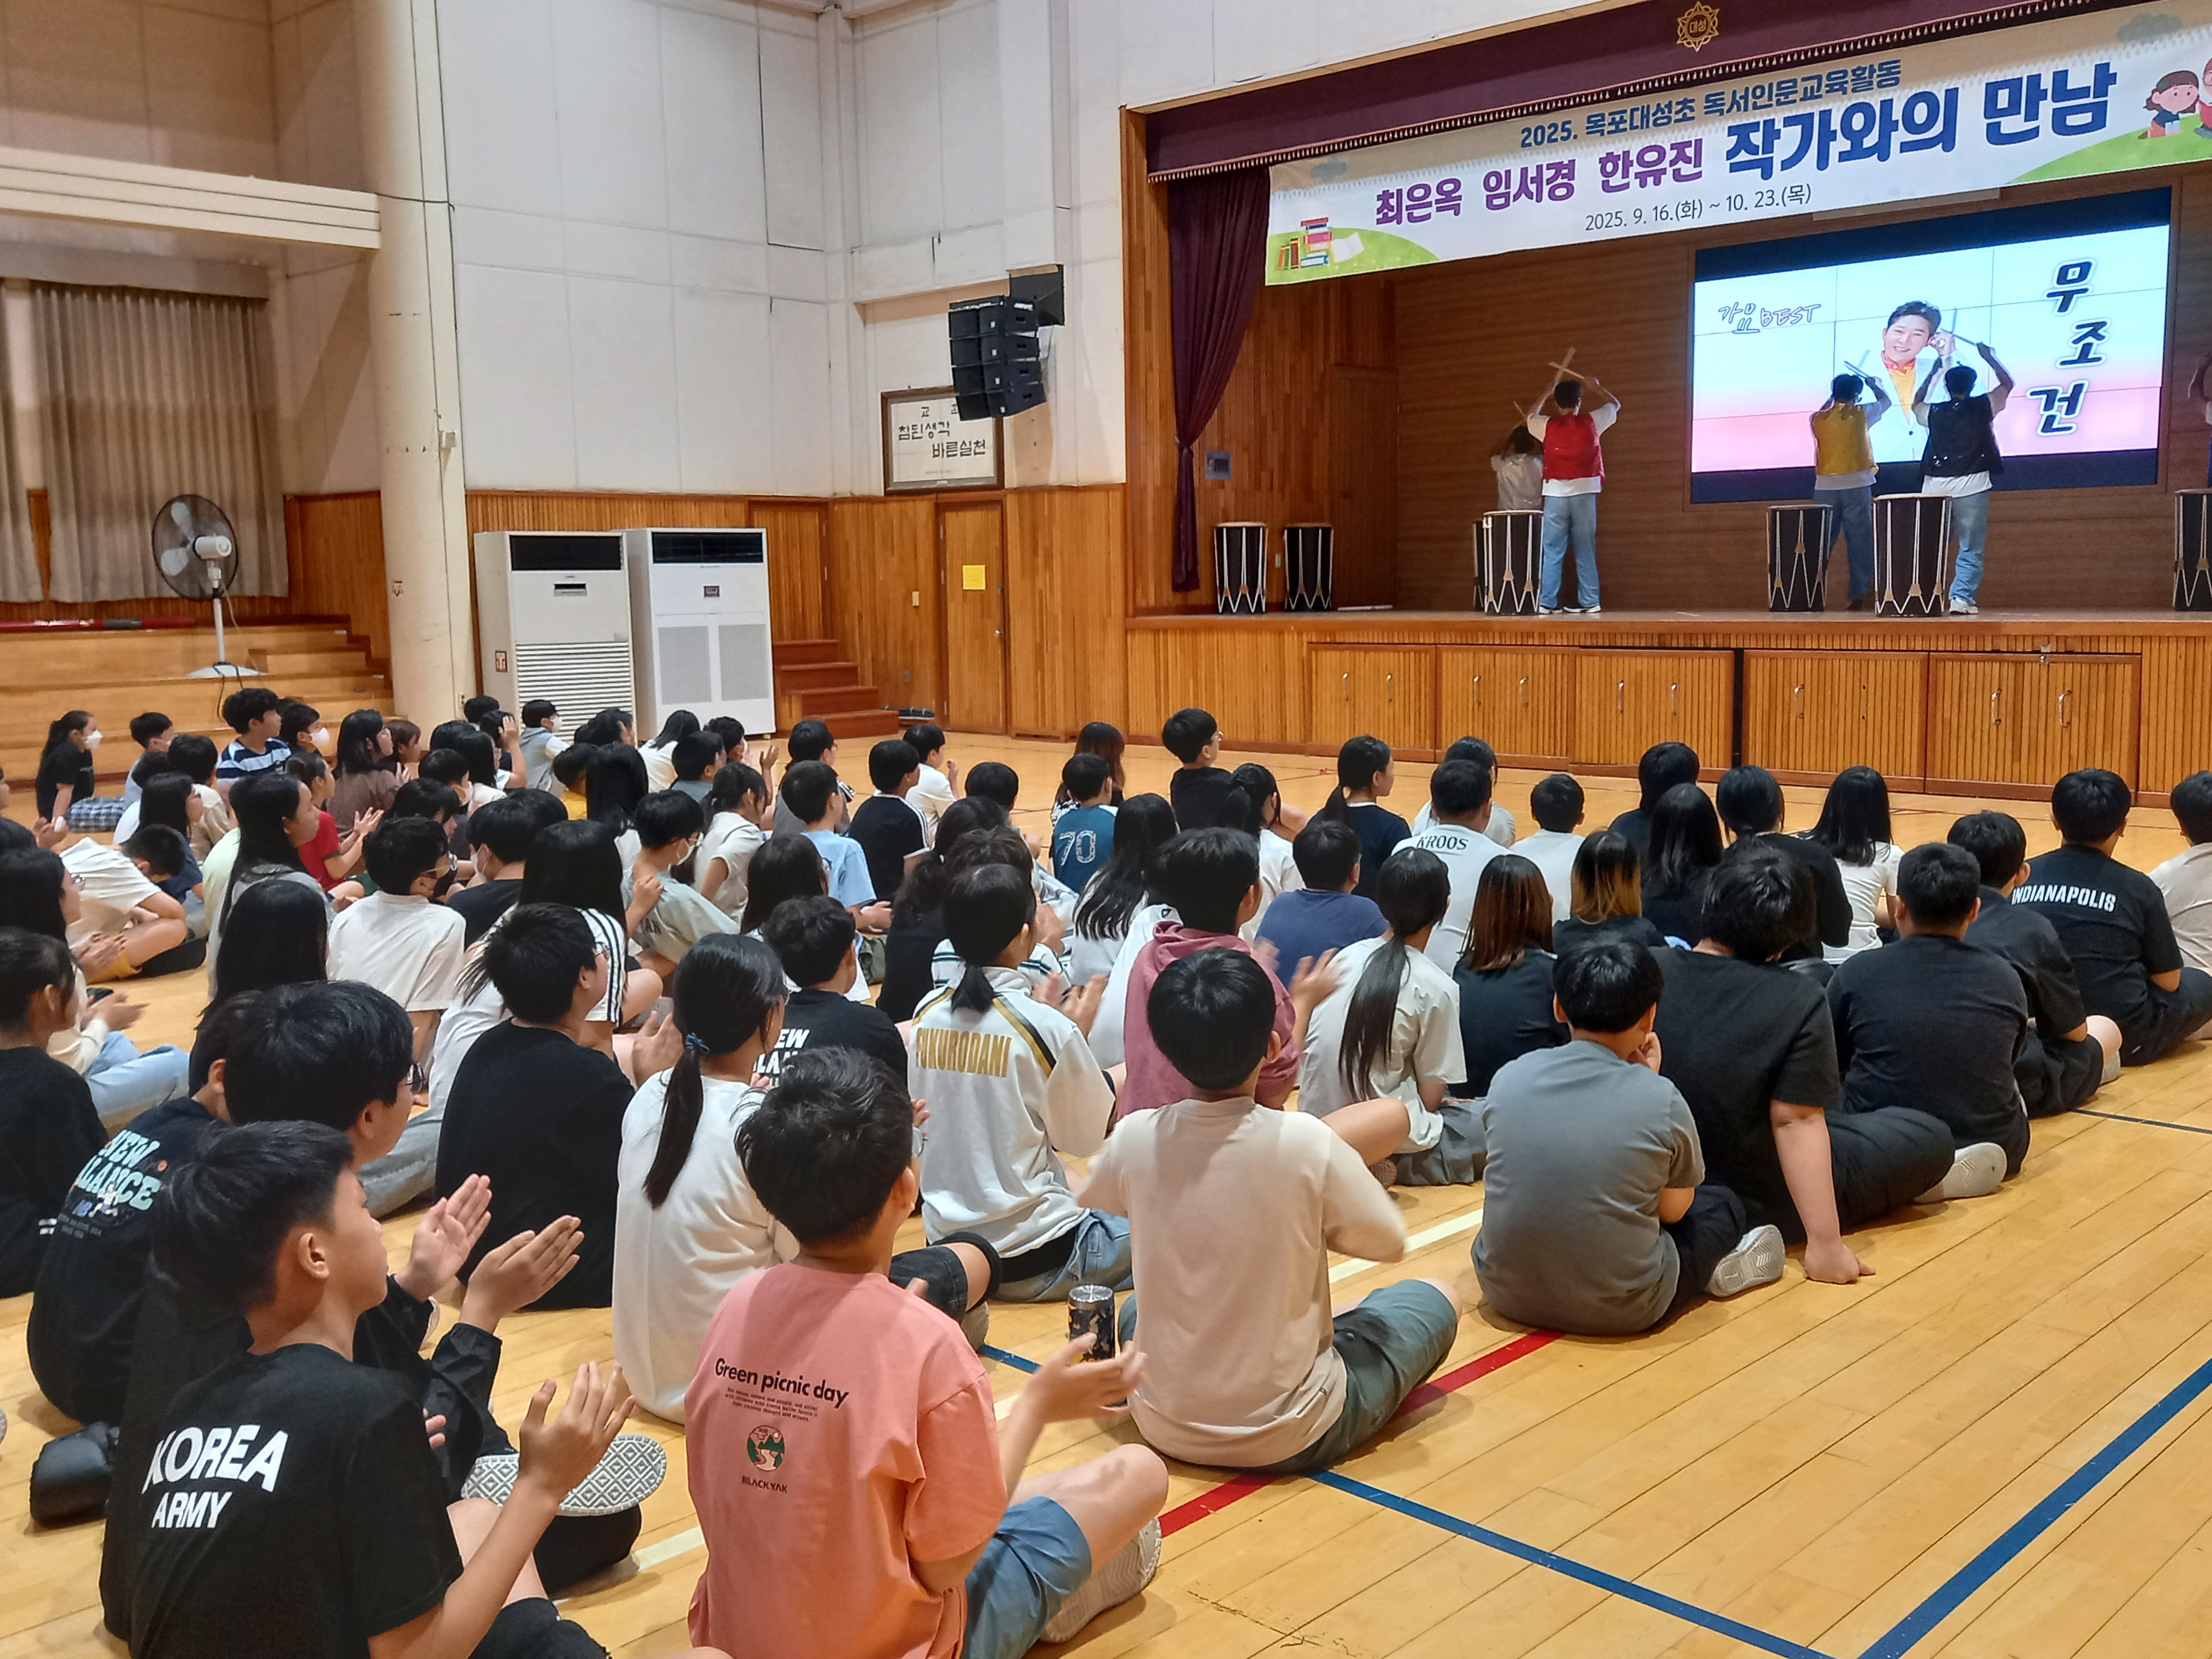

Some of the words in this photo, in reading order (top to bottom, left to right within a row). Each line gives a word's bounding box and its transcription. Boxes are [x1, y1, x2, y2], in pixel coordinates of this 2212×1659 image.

[1689, 18, 1707, 33] 대성
[1520, 120, 1578, 148] 2025.
[1585, 97, 1696, 137] 목포대성초
[1703, 59, 1901, 117] 독서인문교육활동
[1376, 178, 1462, 226] 최은옥
[1483, 159, 1575, 211] 임서경
[1599, 138, 1703, 194] 한유진
[1725, 88, 1959, 181] 작가와의
[1984, 62, 2117, 146] 만남
[1585, 211, 1627, 231] 2025.
[1633, 208, 1647, 225] 9.
[1653, 199, 1703, 222] 16.(화)
[1726, 194, 1748, 211] 10.
[1754, 183, 1812, 208] 23.(목)
[1058, 830, 1097, 866] 70
[1416, 835, 1469, 851] KROOS
[2011, 884, 2117, 912] INDIANAPOLIS
[774, 1028, 810, 1048] EW
[715, 1358, 759, 1385] Green
[760, 1370, 811, 1397] picnic
[813, 1379, 849, 1409] day
[142, 1425, 288, 1493] KOREA
[742, 1475, 769, 1490] BLACK
[770, 1482, 787, 1493] YAK
[151, 1491, 233, 1528] ARMY
